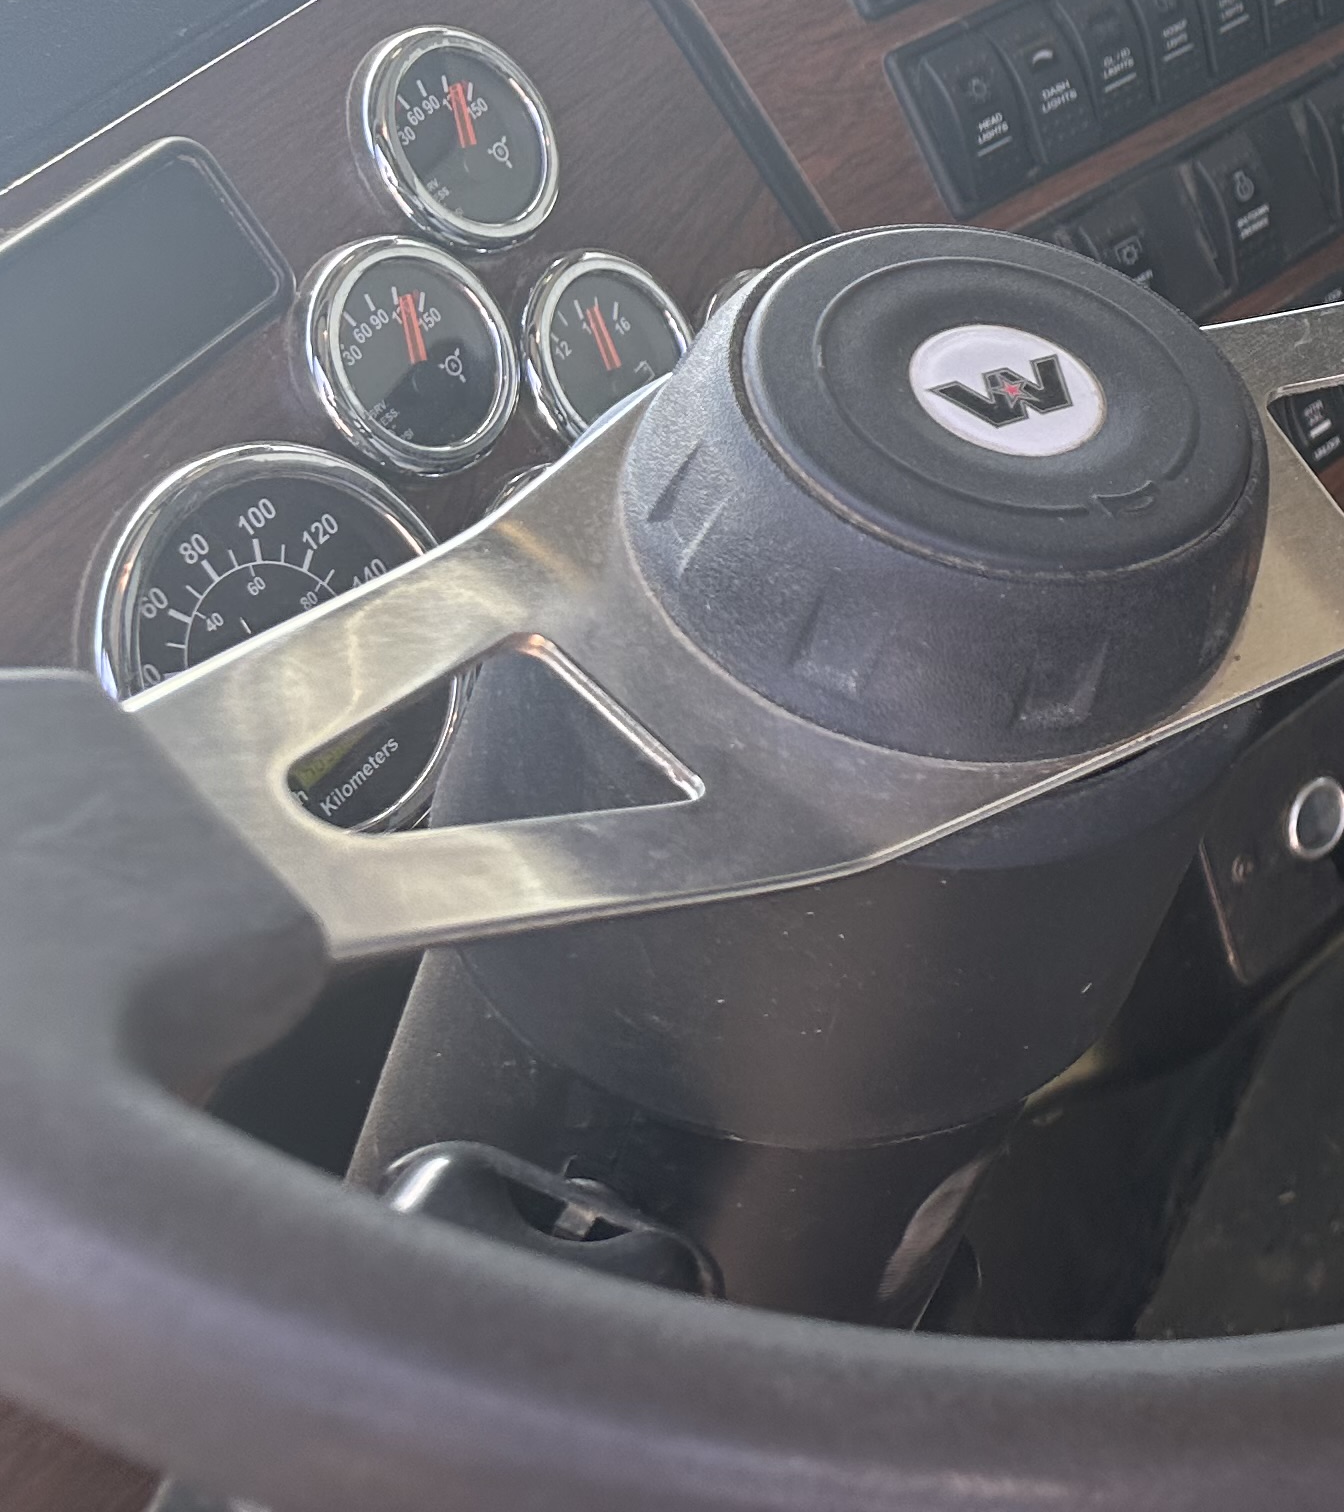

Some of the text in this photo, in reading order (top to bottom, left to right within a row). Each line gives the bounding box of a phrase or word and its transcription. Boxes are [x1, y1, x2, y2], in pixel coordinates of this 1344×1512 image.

[1042, 79, 1071, 100] DASH
[422, 95, 440, 115] 90
[467, 97, 488, 120] 150
[1042, 90, 1078, 113] LIGHTS
[407, 107, 425, 126] 60
[978, 112, 1003, 132] HEAD
[398, 126, 416, 146] 30
[369, 308, 389, 330] 90
[418, 307, 442, 332] 150
[615, 316, 632, 335] 16
[353, 324, 373, 345] 60
[342, 344, 363, 366] 30
[555, 341, 573, 361] 12
[238, 498, 277, 536] 100
[302, 513, 339, 550] 120
[179, 533, 209, 566] 80
[247, 576, 267, 597] 60
[141, 587, 169, 620] 60
[300, 590, 319, 610] 80
[205, 612, 225, 633] 40
[142, 664, 162, 688] 0
[320, 737, 399, 816] Kilometers
